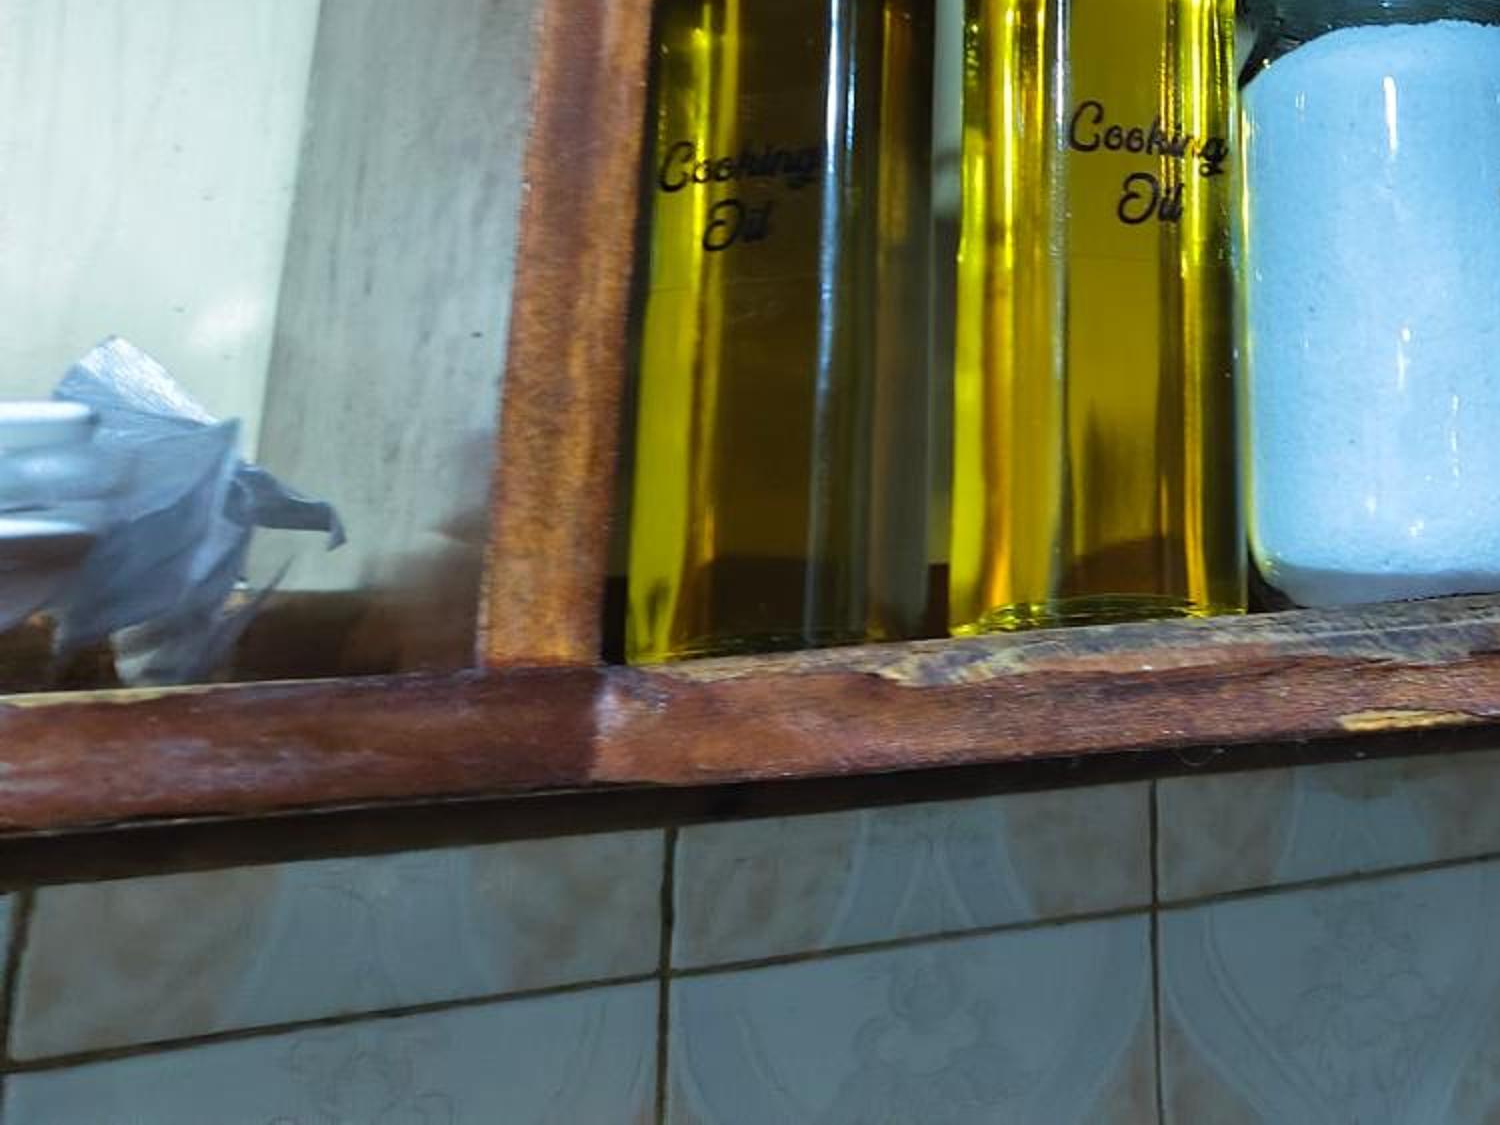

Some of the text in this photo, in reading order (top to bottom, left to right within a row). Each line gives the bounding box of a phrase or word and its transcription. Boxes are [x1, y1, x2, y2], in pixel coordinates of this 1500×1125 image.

[1068, 99, 1229, 177] Cooking
[658, 140, 822, 192] Cooking
[703, 198, 771, 251] Oil
[1117, 172, 1186, 225] Oil
